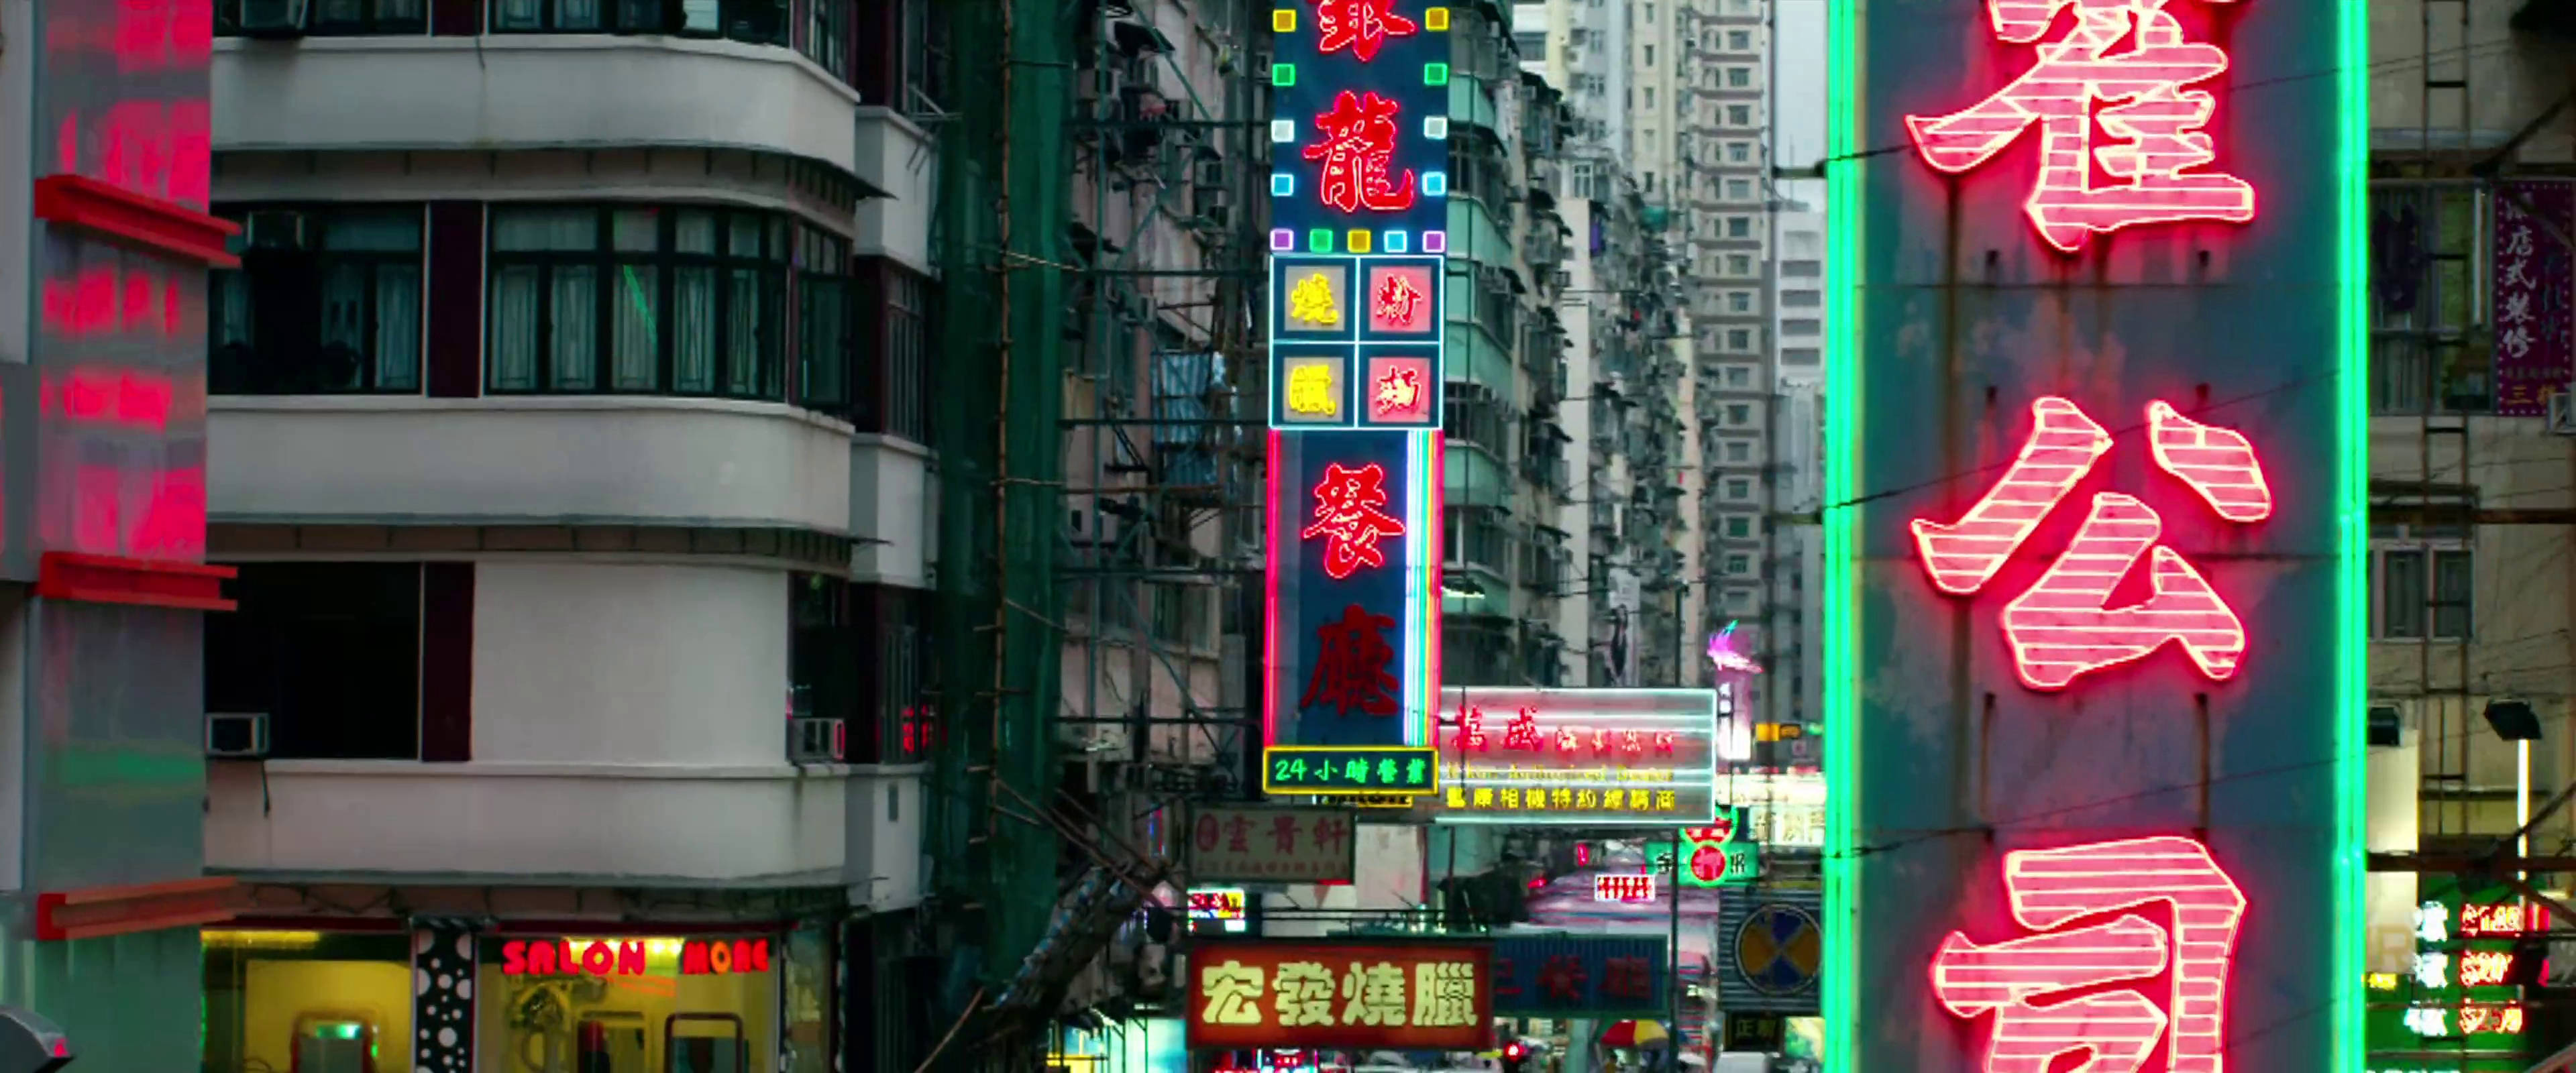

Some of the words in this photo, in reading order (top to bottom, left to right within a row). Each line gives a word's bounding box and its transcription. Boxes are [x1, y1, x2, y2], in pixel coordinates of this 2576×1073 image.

[502, 940, 646, 975] SALON
[1202, 960, 1478, 1027] 宏發燒臘
